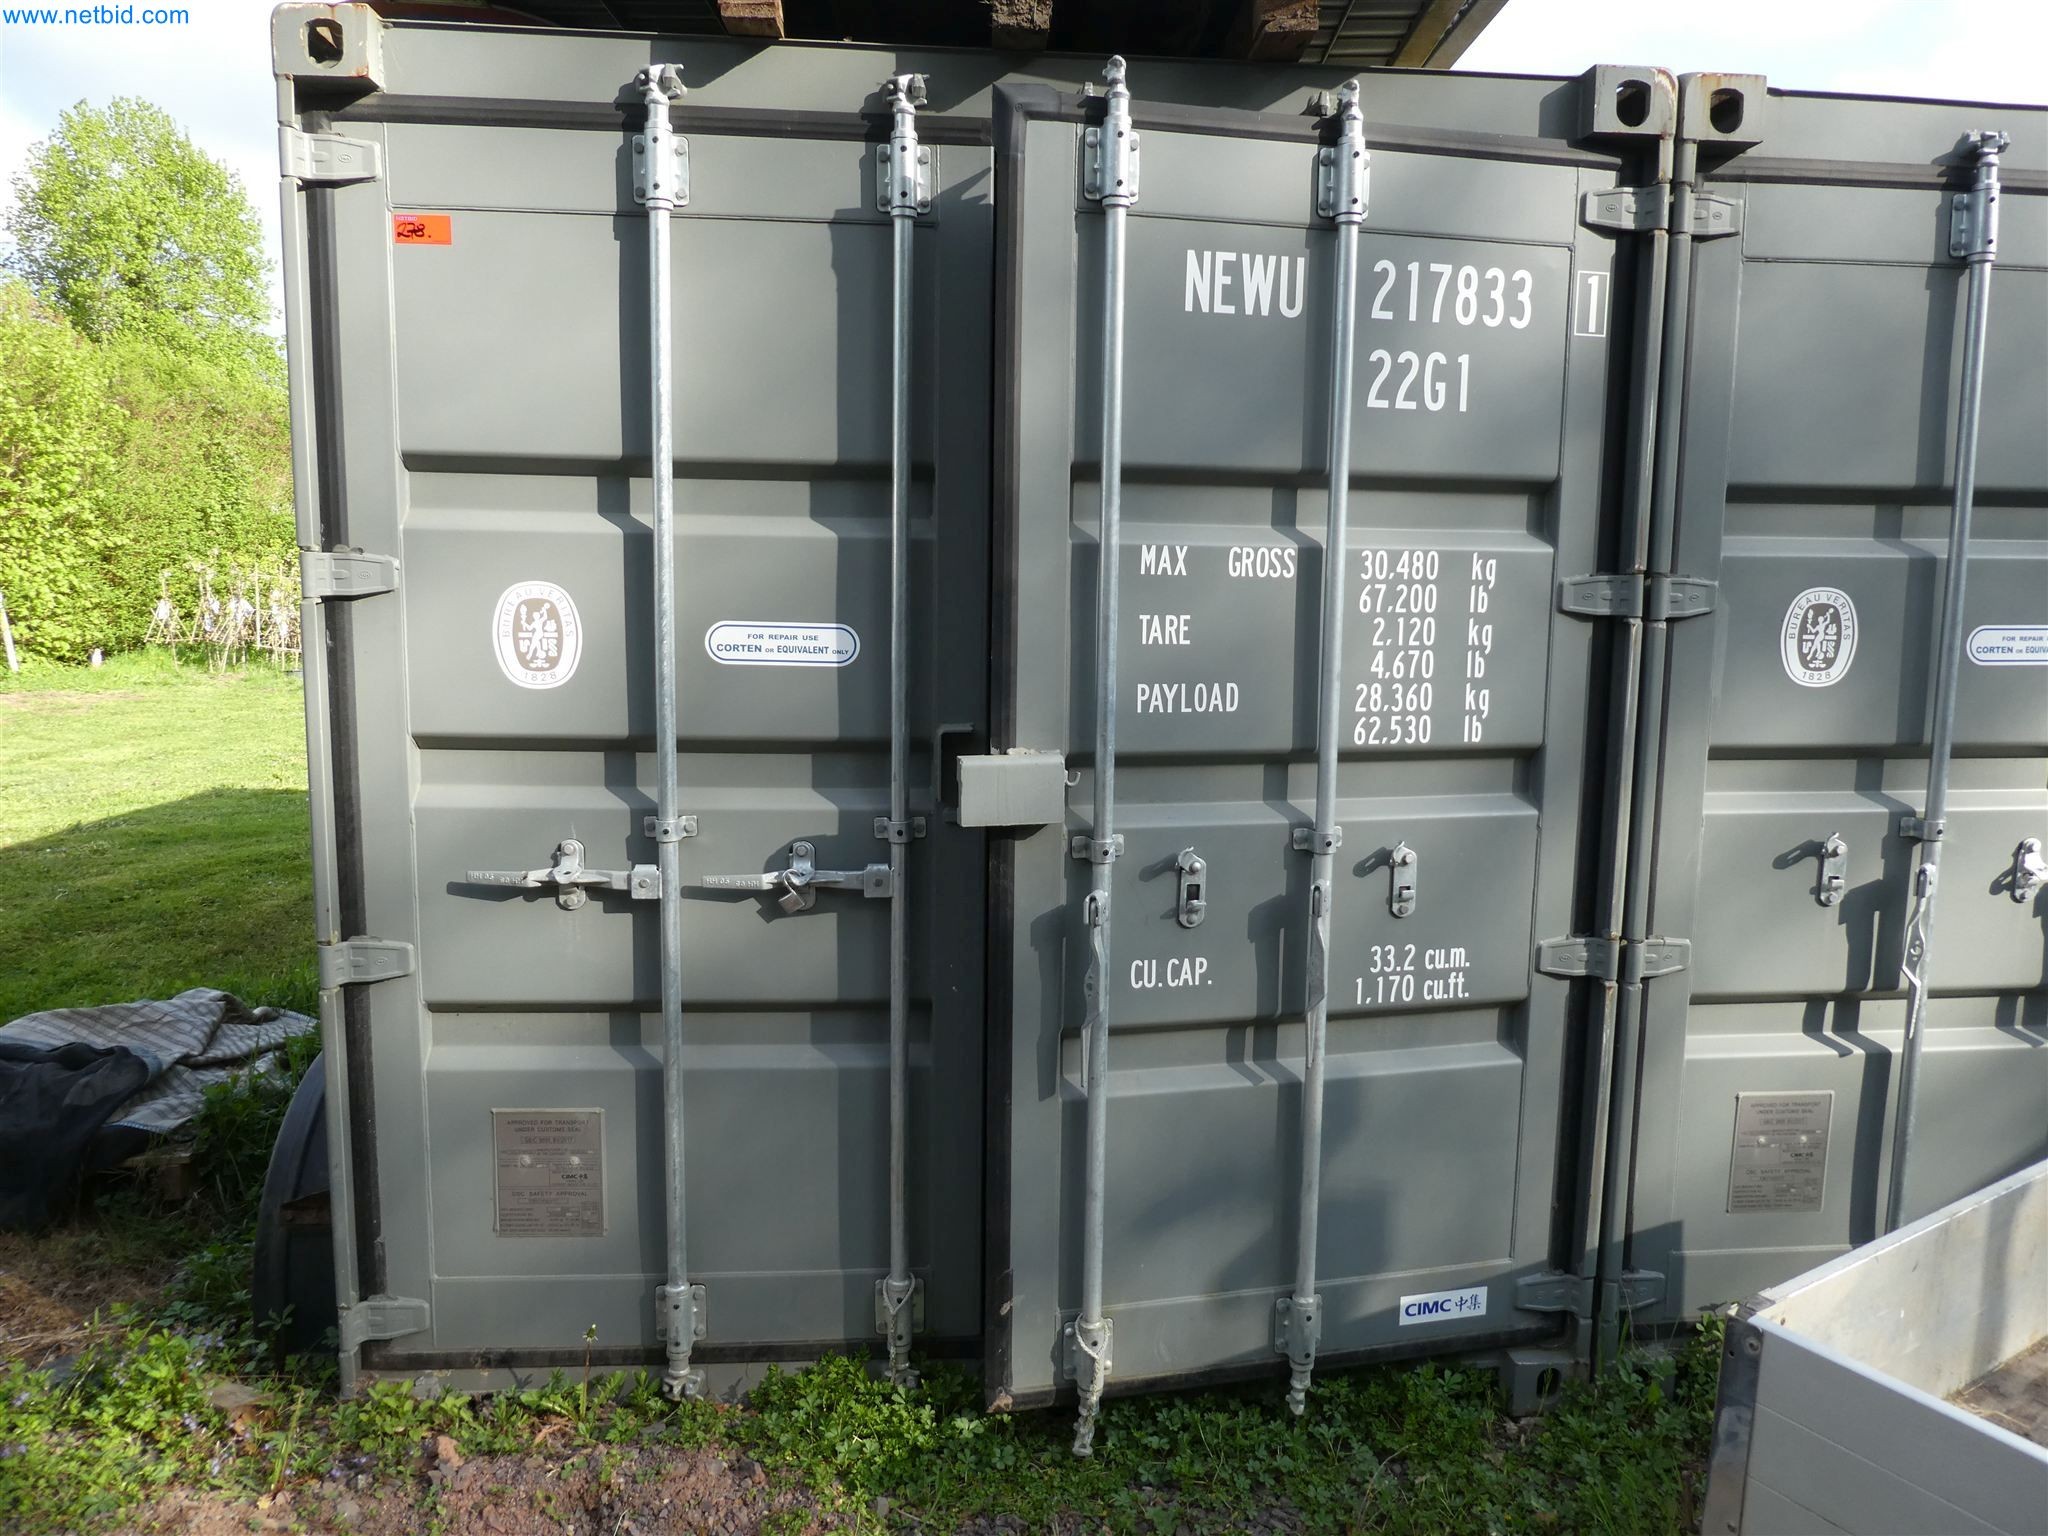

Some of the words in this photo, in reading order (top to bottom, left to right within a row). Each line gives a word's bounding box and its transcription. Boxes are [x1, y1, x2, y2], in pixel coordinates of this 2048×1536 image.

[1185, 249, 1305, 319] NEWU
[1371, 259, 1533, 329] 217833
[1586, 275, 1600, 333] 1
[1366, 349, 1470, 412] 22G1
[1140, 544, 1188, 576] MAX
[1228, 547, 1296, 578] GROSS
[1360, 550, 1439, 581] 30,480
[1471, 552, 1496, 590] kg
[1359, 583, 1438, 614] 67,200
[1469, 585, 1488, 614] lb
[1789, 594, 1820, 639] BUREAU
[1826, 594, 1851, 640] VERITAS
[717, 644, 762, 652] CORTEN
[777, 645, 829, 654] EQUIVALENT
[1139, 614, 1191, 645] TARE
[1372, 617, 1435, 647] 2,120
[1467, 618, 1492, 654] kg
[1370, 650, 1434, 680] 4,670
[1466, 651, 1485, 679] lb
[1976, 646, 2013, 654] CORTEN
[524, 672, 557, 681] 1828
[1803, 671, 1831, 680] 1828
[1136, 682, 1239, 713] PAYLOAD
[1354, 683, 1433, 713] 28,360
[1464, 684, 1490, 720] kg
[1353, 715, 1431, 745] 62,530
[1463, 716, 1482, 743] lb
[1369, 943, 1415, 973] 33.2
[1424, 946, 1470, 971] cu.m.
[1355, 974, 1415, 1005] 1,170
[1424, 971, 1469, 1001] cu.ft.
[1405, 1298, 1451, 1317] CIMC
